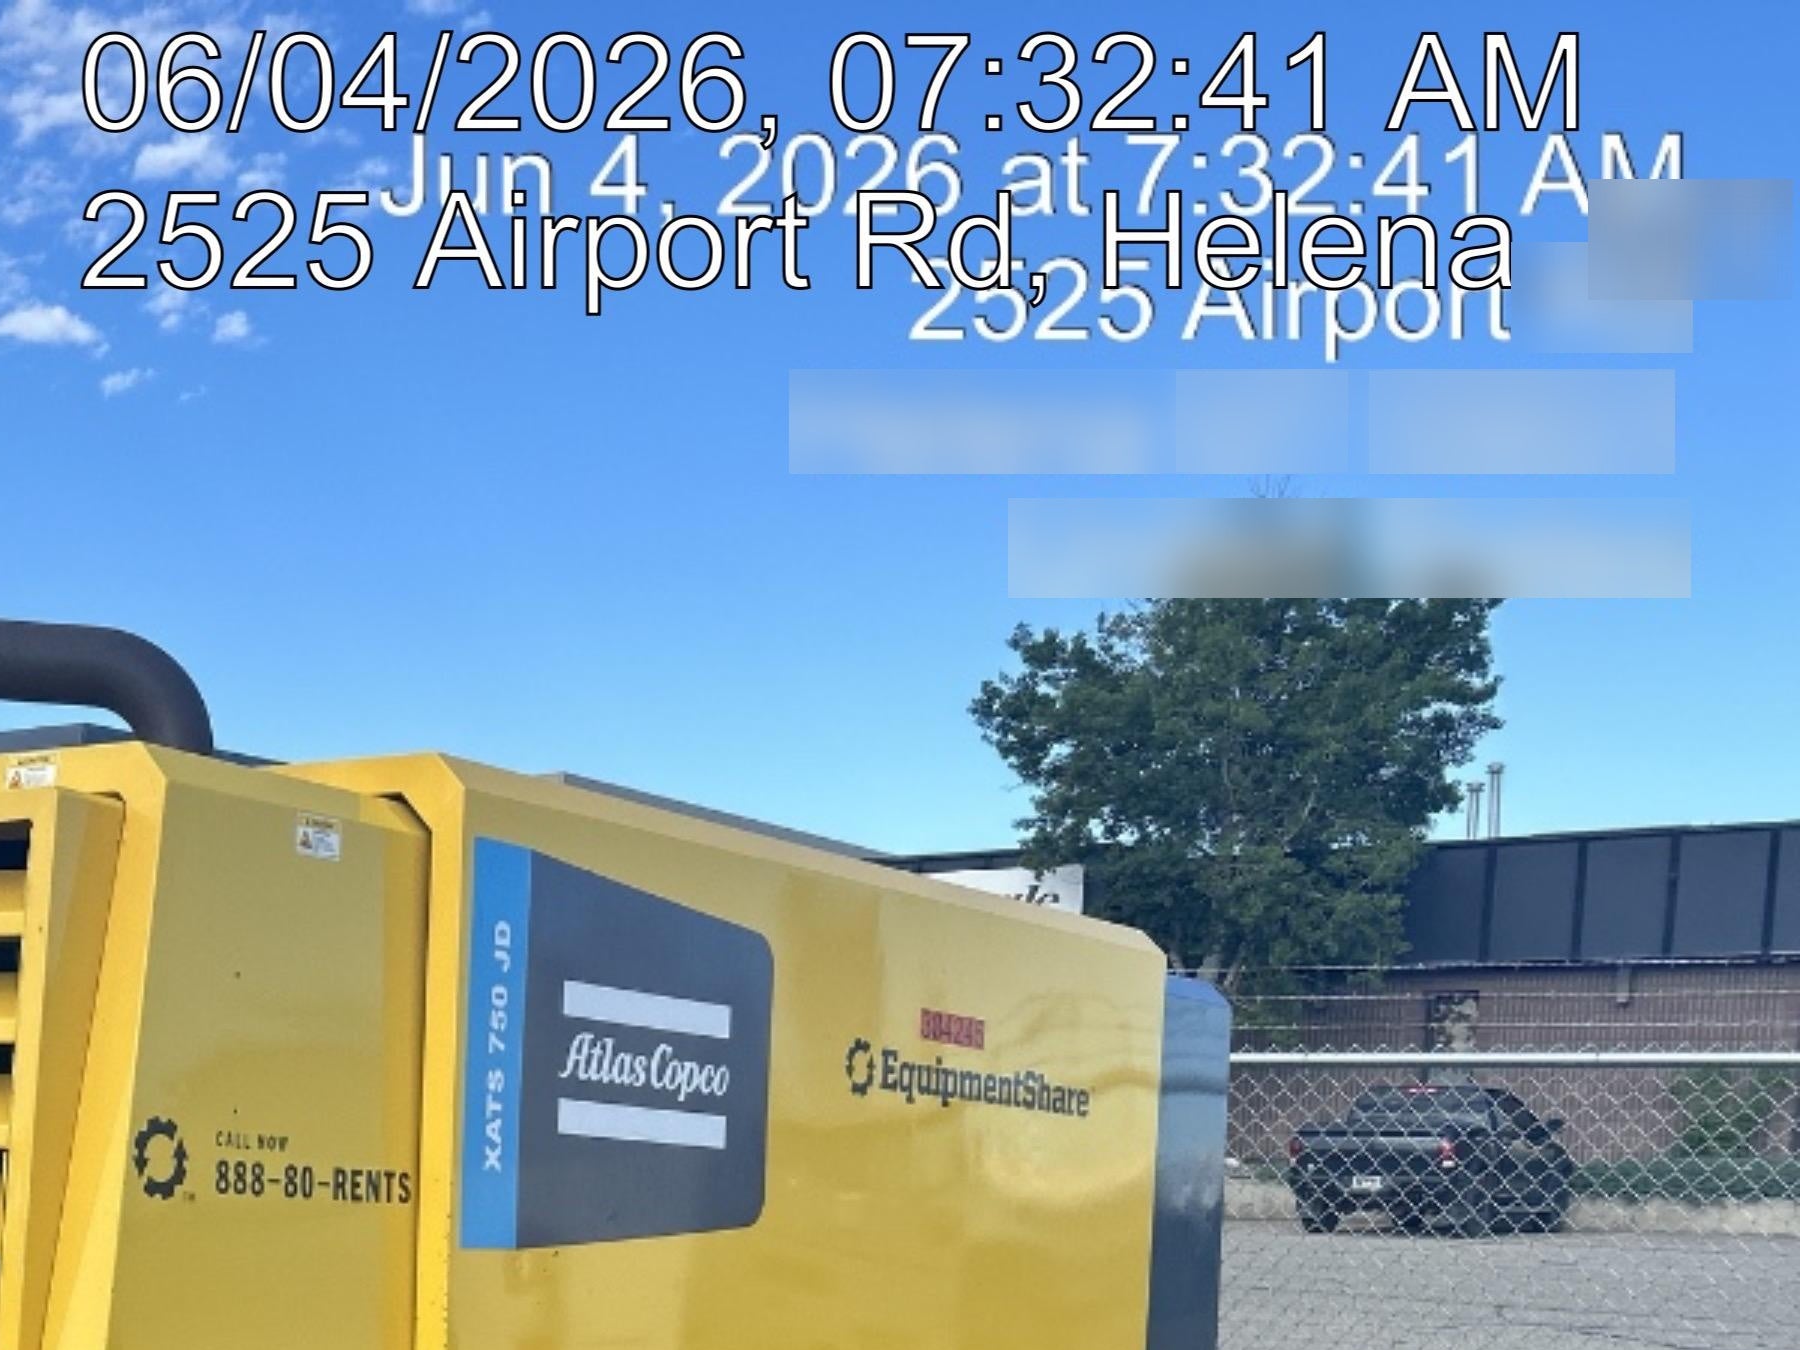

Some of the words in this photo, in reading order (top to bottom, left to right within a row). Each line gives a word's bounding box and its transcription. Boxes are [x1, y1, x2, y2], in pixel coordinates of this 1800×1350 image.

[494, 920, 512, 973] JD
[488, 985, 509, 1054] 750
[557, 1032, 648, 1087] Atlas
[649, 1043, 731, 1101] Copco
[880, 1049, 1091, 1117] EquipmentShare
[215, 1130, 251, 1150] CALL
[256, 1133, 289, 1152] NOW
[481, 1069, 505, 1172] XATS
[215, 1159, 412, 1203] 888-80-RENTS
